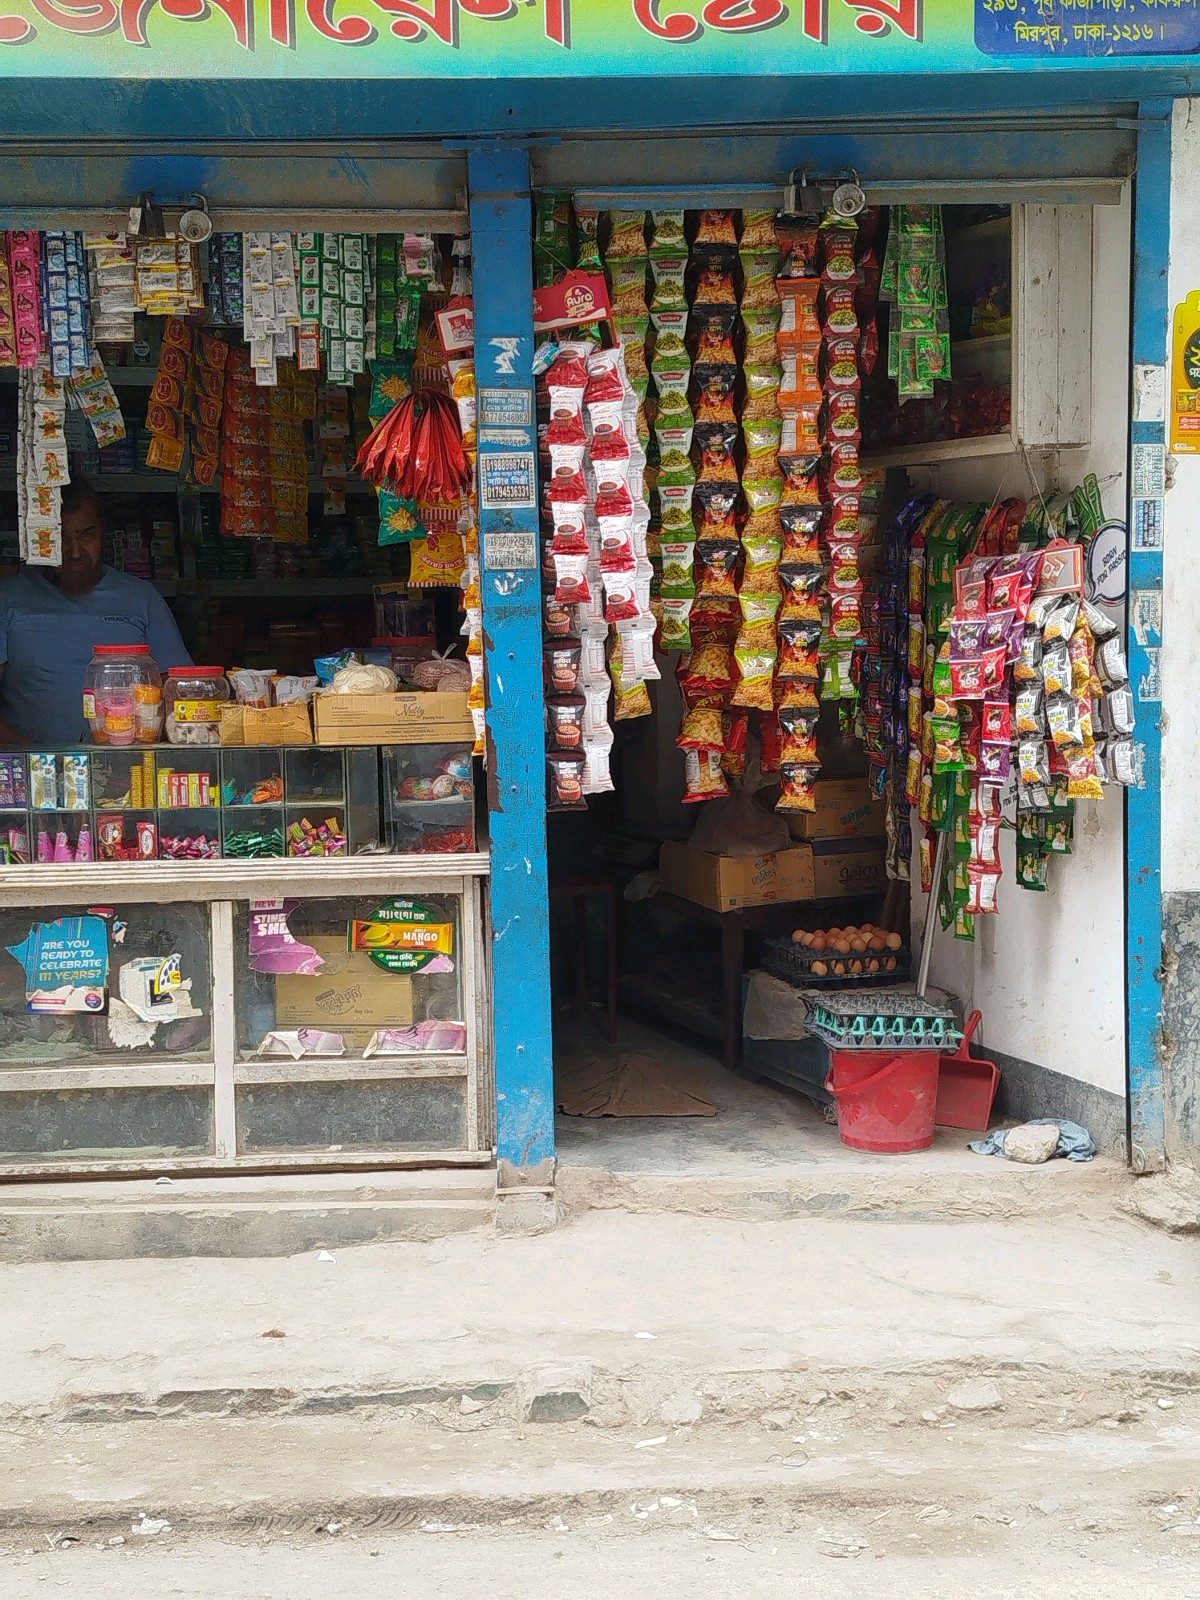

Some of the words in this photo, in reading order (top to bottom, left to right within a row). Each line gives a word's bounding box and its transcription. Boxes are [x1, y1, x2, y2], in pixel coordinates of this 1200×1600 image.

[1072, 23, 1154, 42] ঢাকা-১২১৬
[1102, 545, 1117, 567] BORN
[1097, 570, 1108, 586] FOR
[255, 899, 277, 907] NEW
[253, 913, 288, 924] STING
[403, 931, 438, 942] MANGO
[41, 941, 65, 950] ARE
[66, 940, 90, 949] YOU
[41, 950, 79, 960] READY
[80, 949, 95, 958] TO
[39, 959, 102, 970] CELEBRATE
[55, 969, 102, 980] YEARS?
